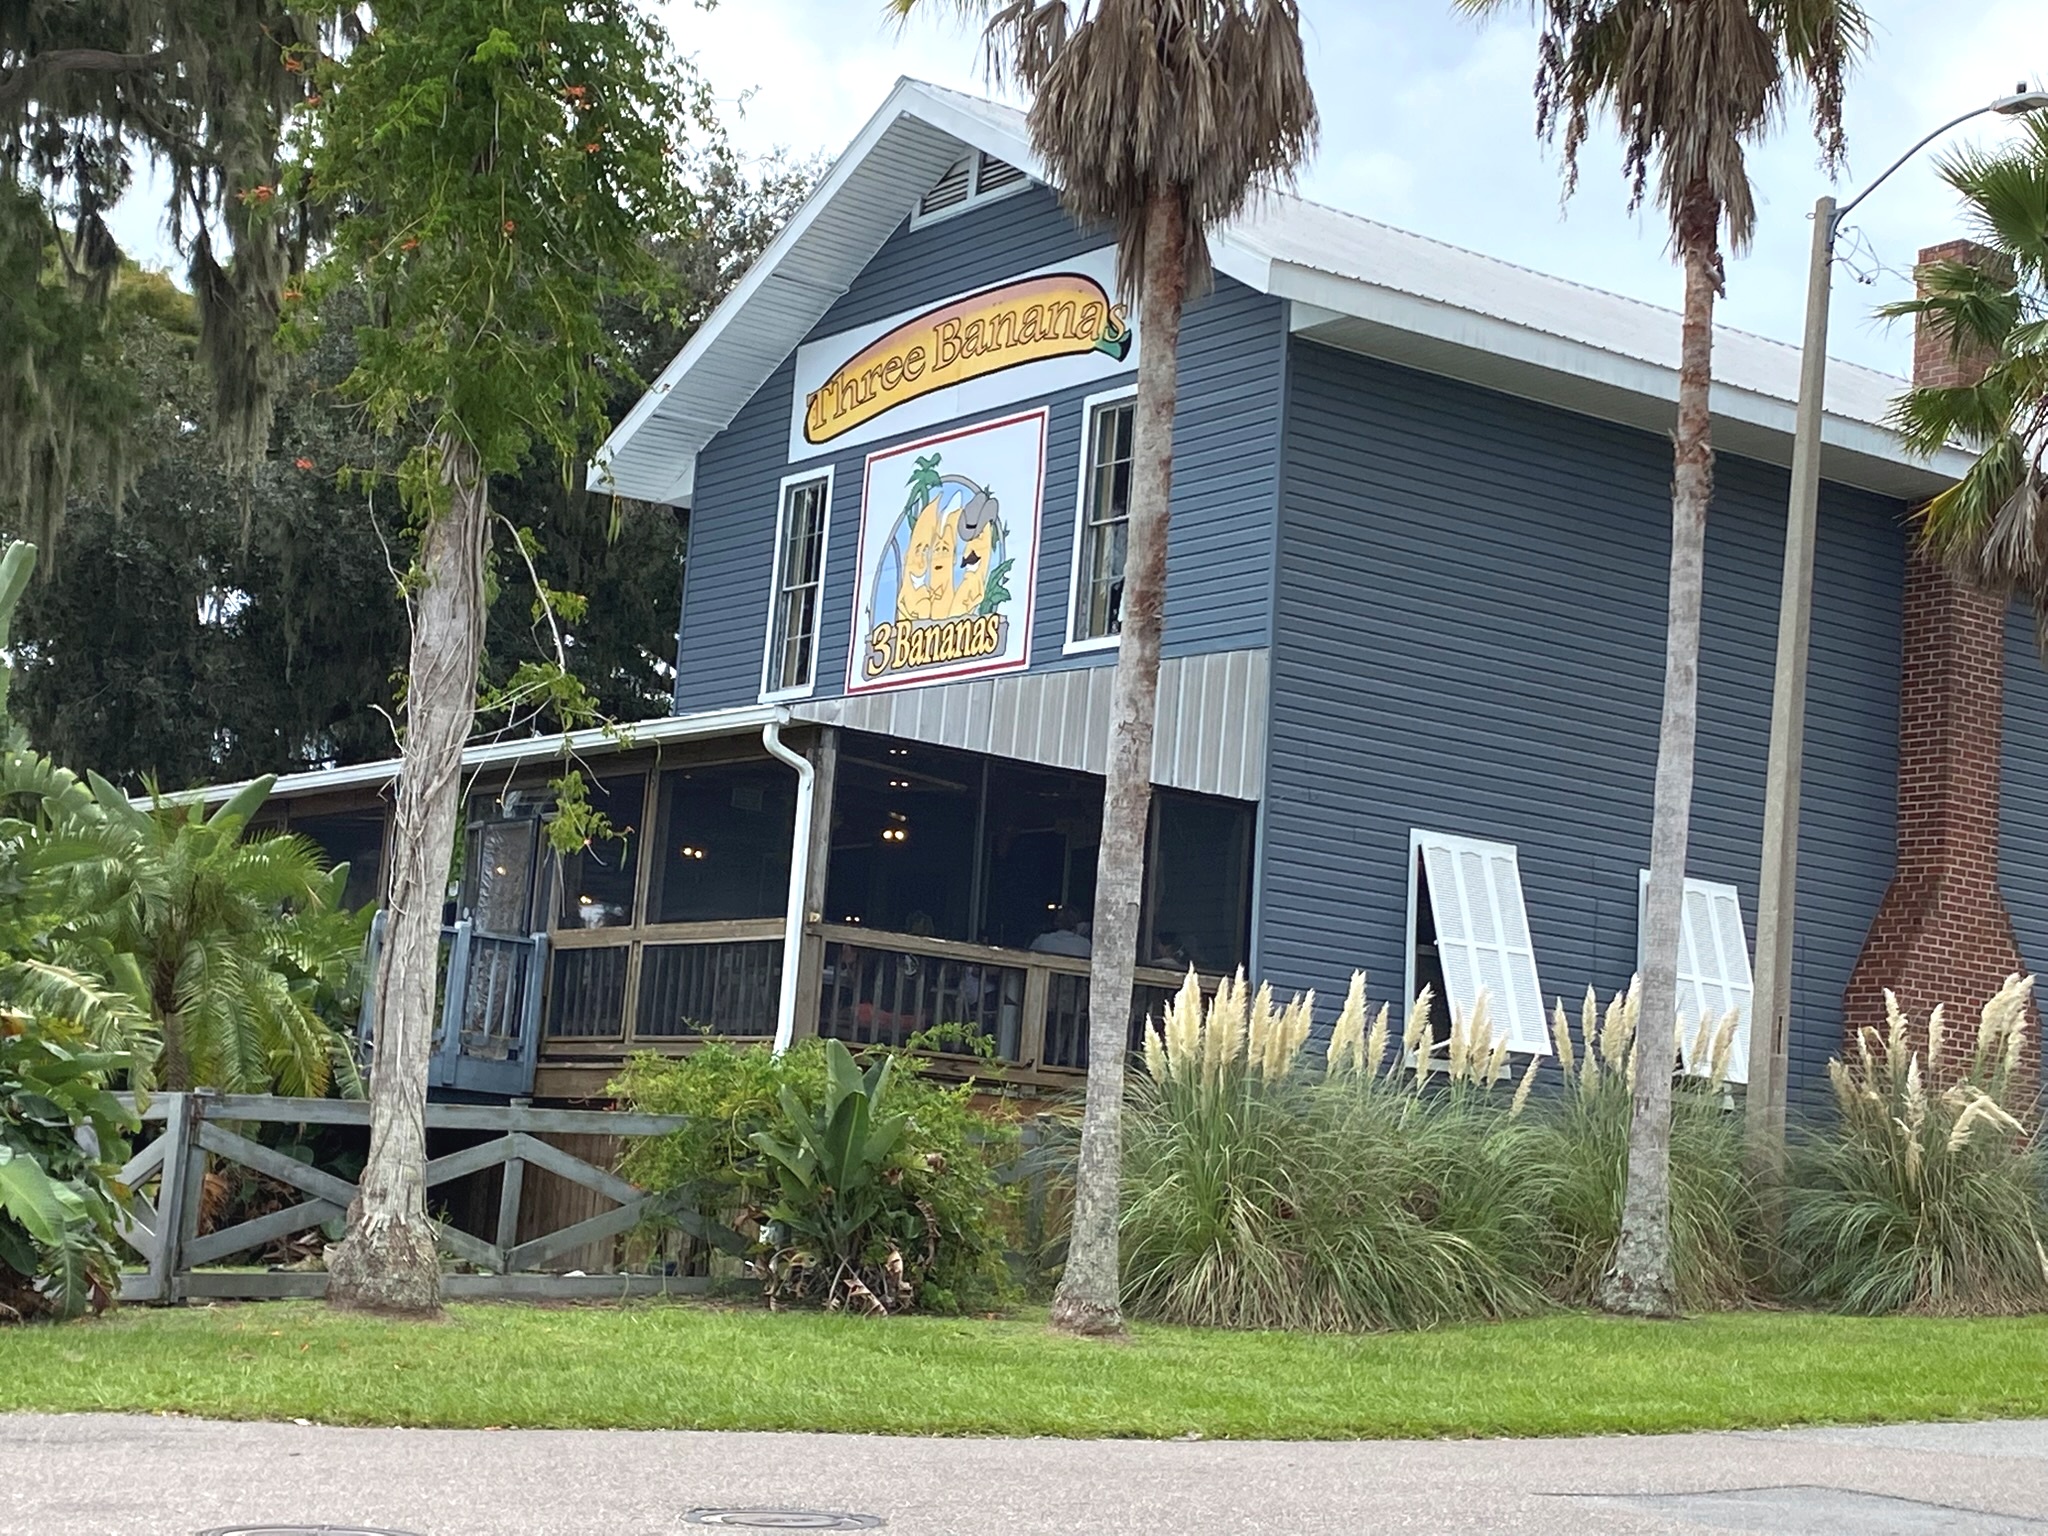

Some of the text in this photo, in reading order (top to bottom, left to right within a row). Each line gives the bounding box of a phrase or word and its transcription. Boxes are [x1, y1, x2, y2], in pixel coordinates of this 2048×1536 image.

[806, 297, 1128, 431] Three Bananas
[867, 613, 1001, 676] 3 Bananas
